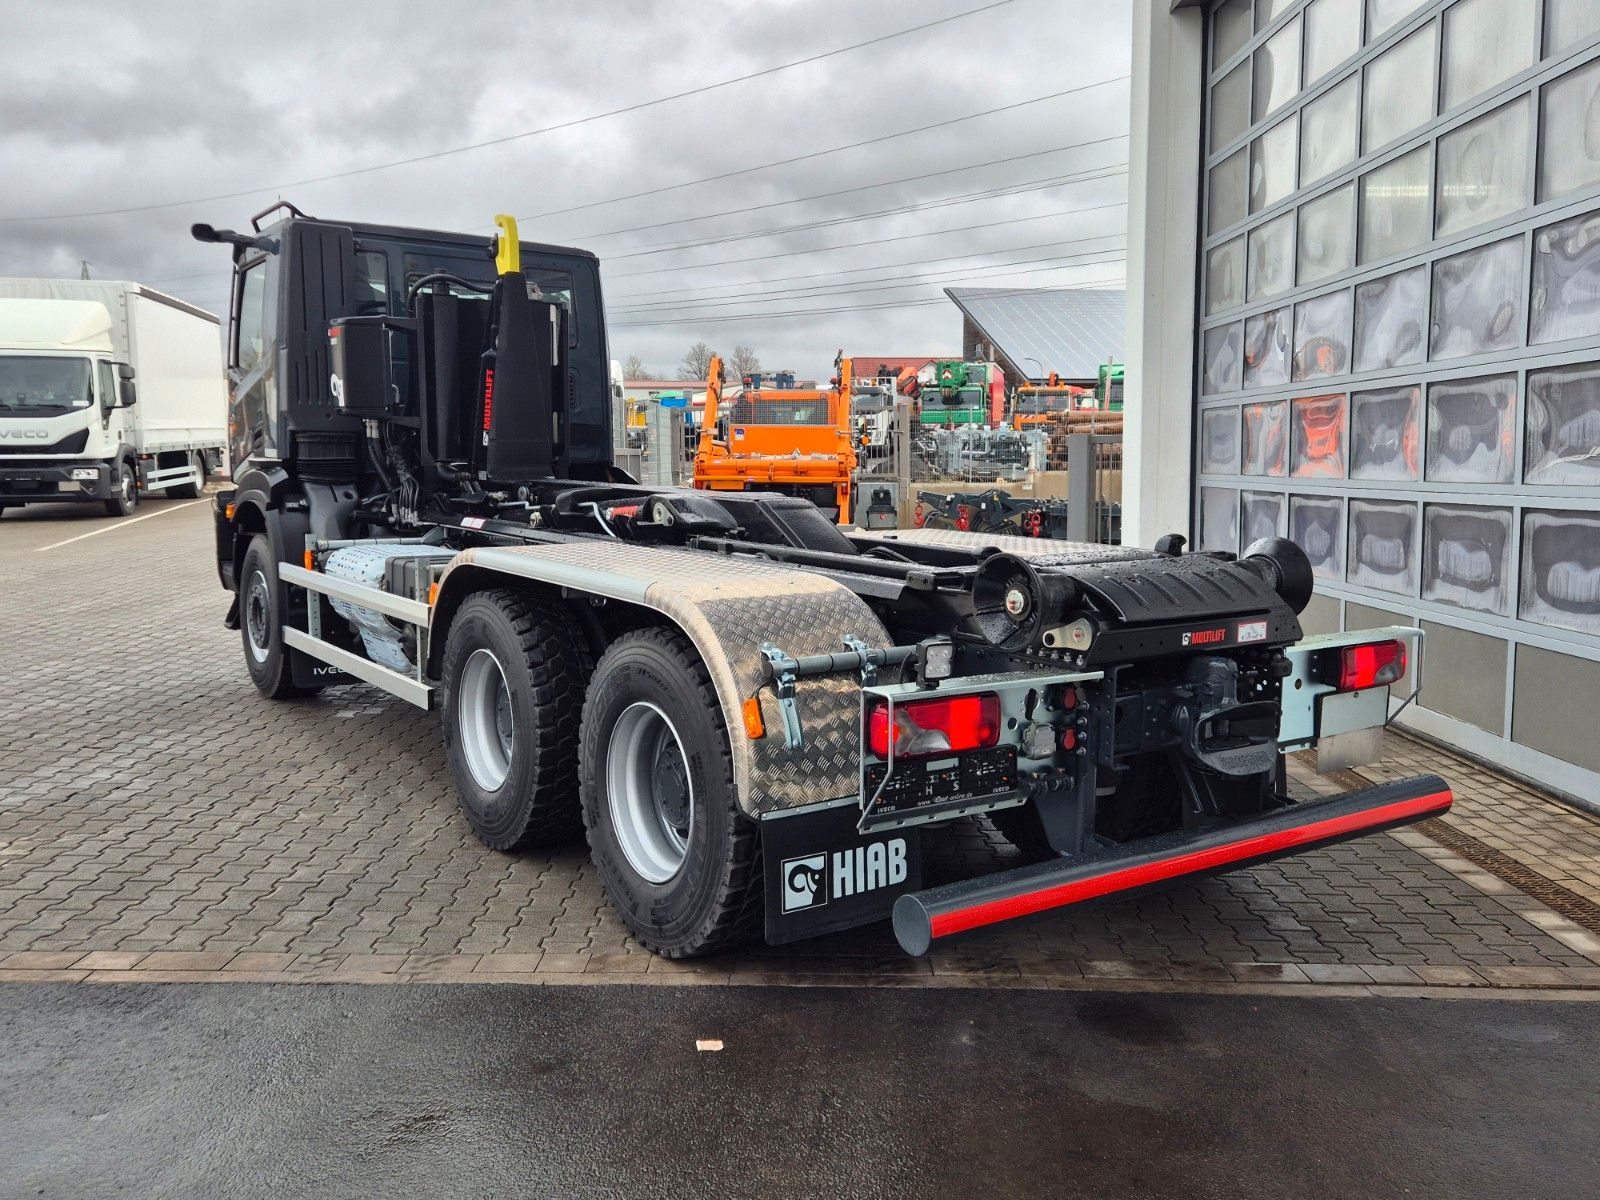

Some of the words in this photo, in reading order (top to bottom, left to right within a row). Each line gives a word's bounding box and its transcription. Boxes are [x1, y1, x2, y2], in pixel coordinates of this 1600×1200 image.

[483, 368, 493, 430] MULTILIFT
[0, 429, 49, 439] VECO
[1192, 628, 1226, 644] MULTILIFT
[313, 665, 345, 675] IVEC
[833, 838, 907, 899] HIAB
